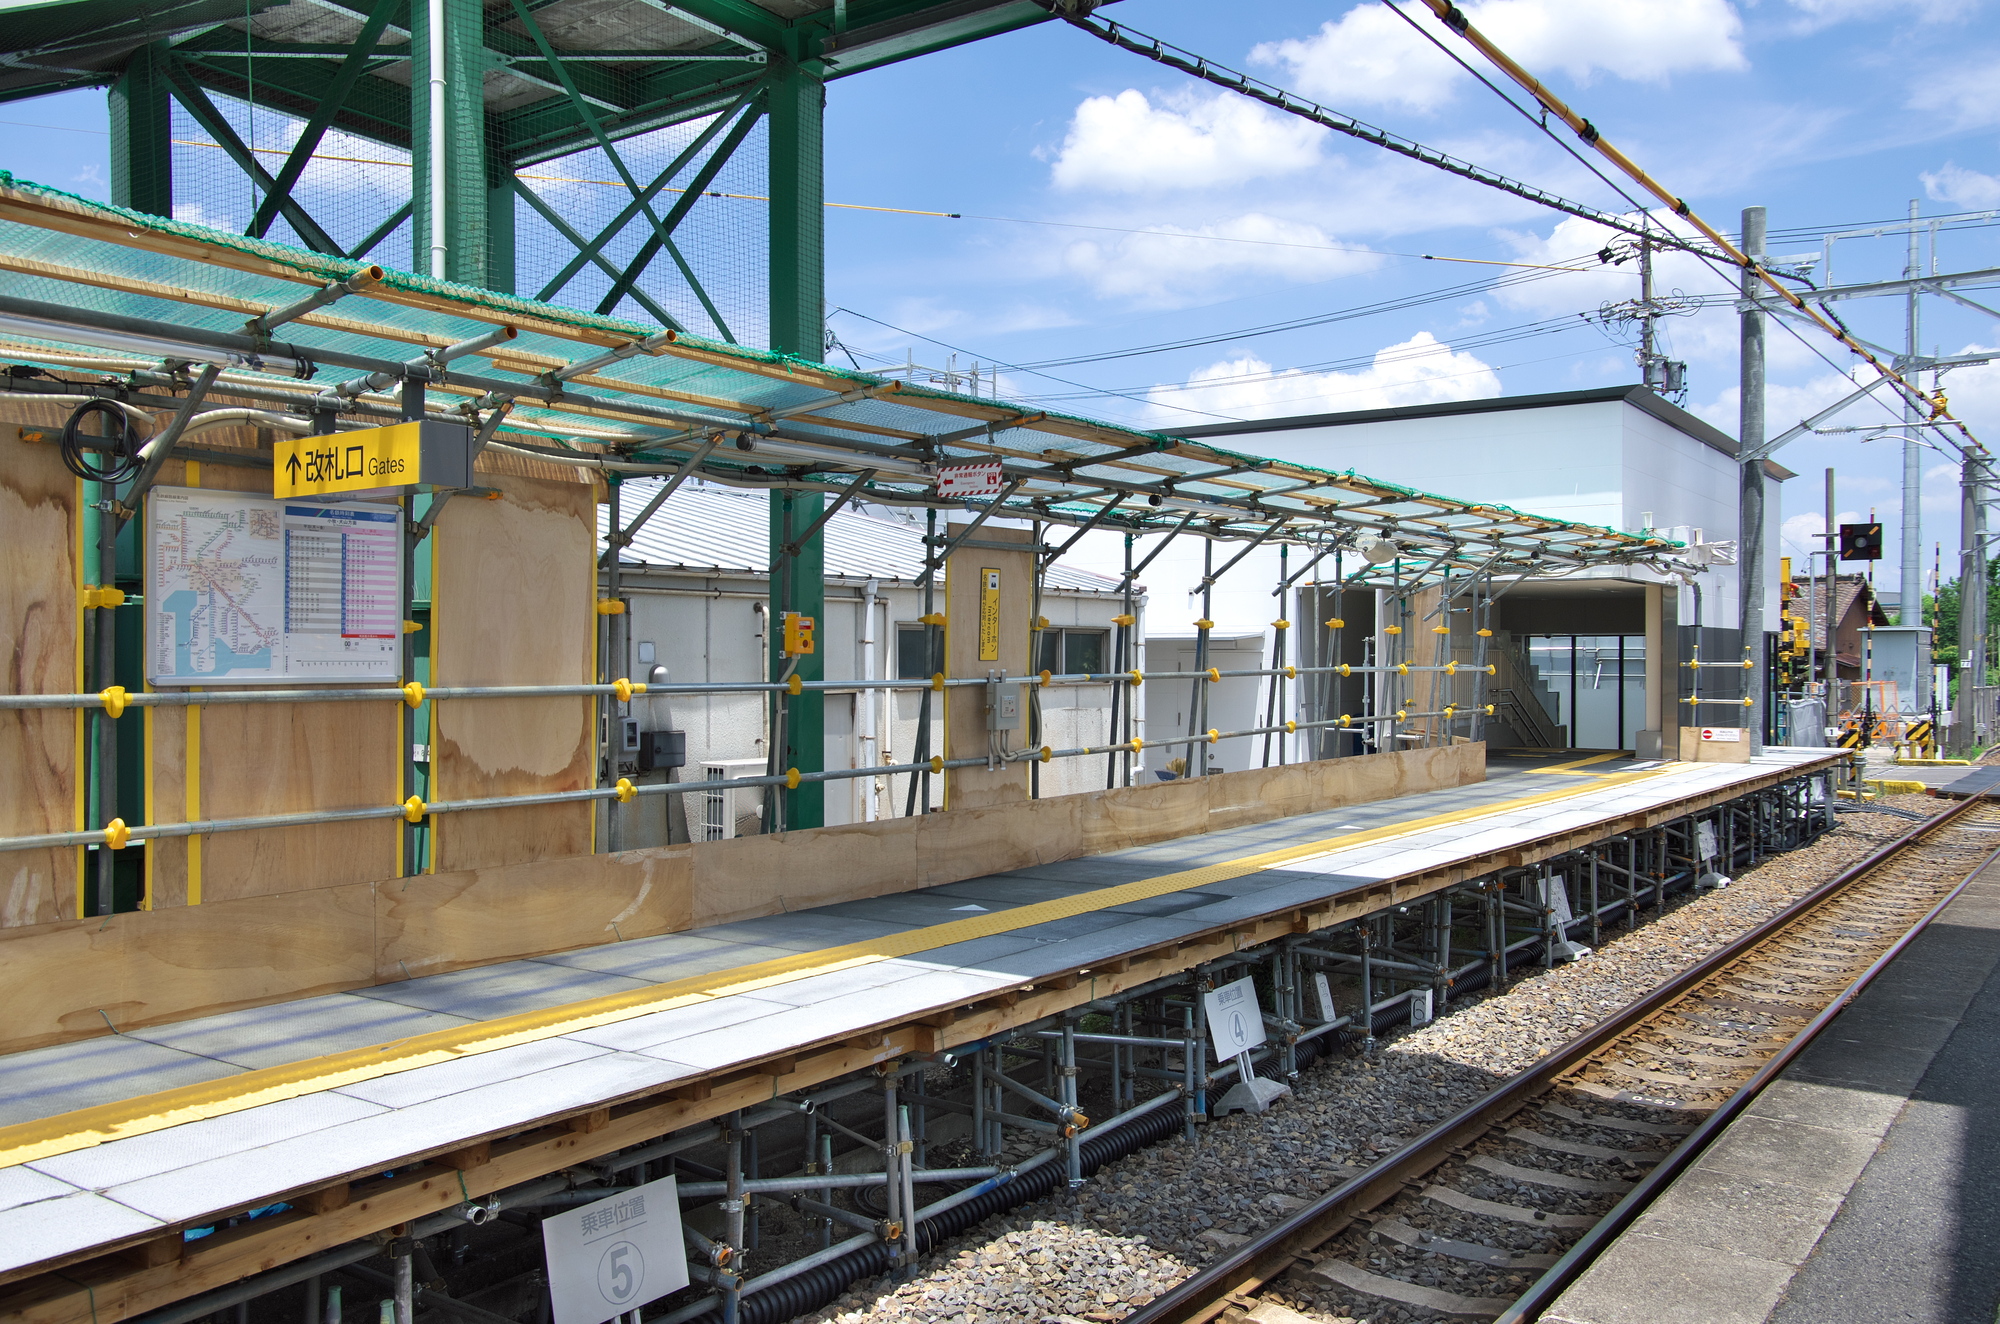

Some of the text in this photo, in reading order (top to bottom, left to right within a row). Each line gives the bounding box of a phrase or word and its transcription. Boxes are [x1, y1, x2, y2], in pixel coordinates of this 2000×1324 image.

[306, 445, 405, 483] 改札口 Gates
[954, 470, 986, 479] 非常通報ボタン
[1217, 985, 1244, 1006] 乗車位置
[1413, 998, 1425, 1021] 6
[581, 1195, 647, 1237] 乗車位置
